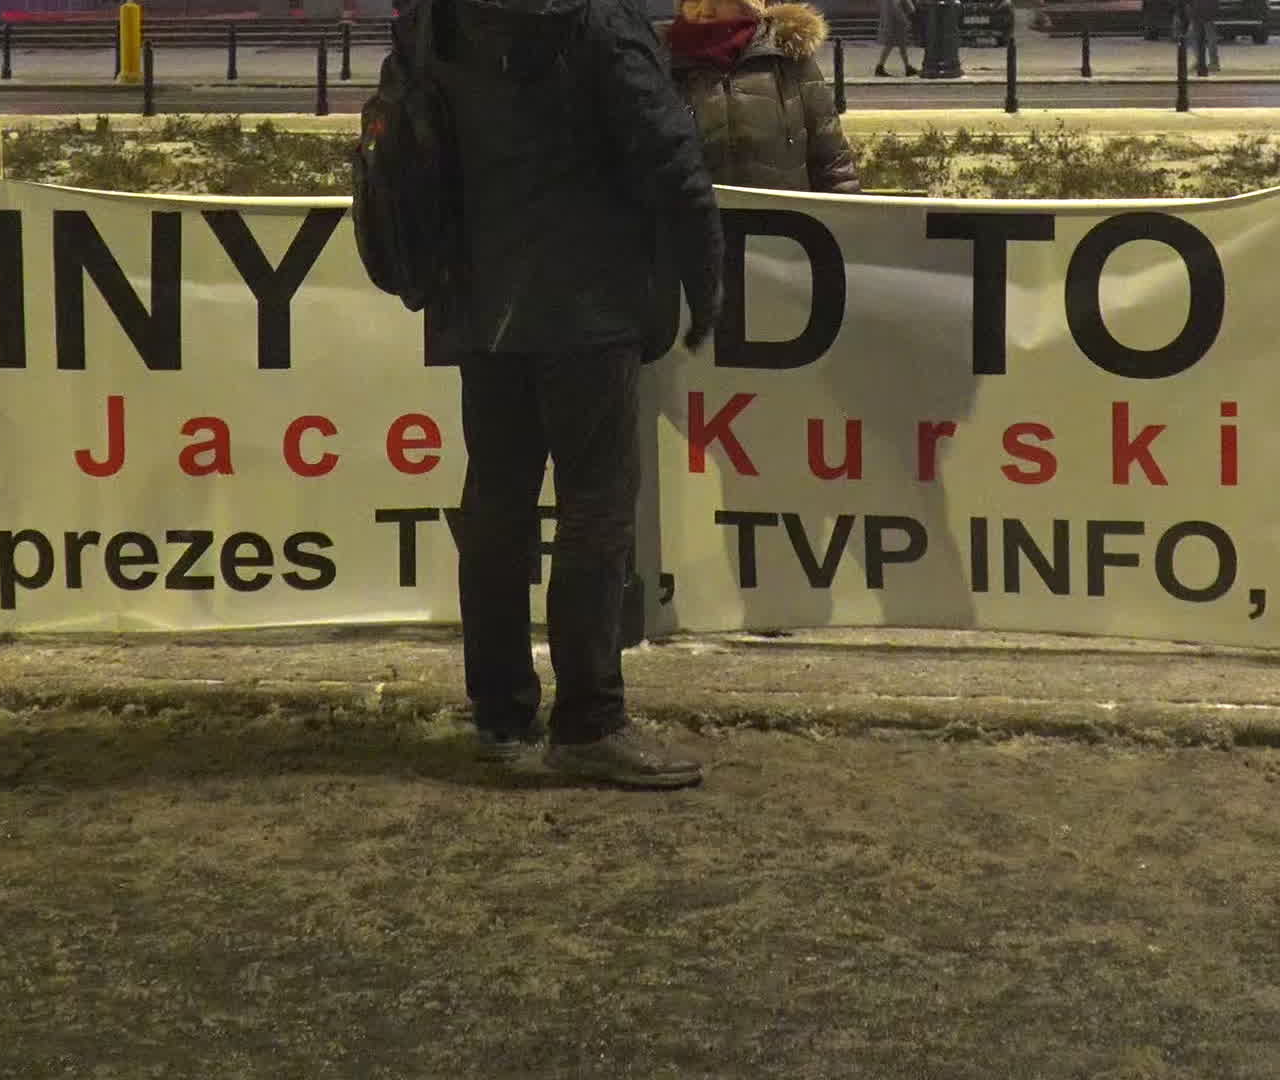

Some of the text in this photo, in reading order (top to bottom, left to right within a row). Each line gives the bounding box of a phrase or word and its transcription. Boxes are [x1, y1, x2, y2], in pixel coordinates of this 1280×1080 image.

[926, 211, 1226, 380] TO
[74, 391, 1238, 487] Jace Kurski
[714, 510, 930, 590] TVP
[970, 517, 1267, 619] INFO,
